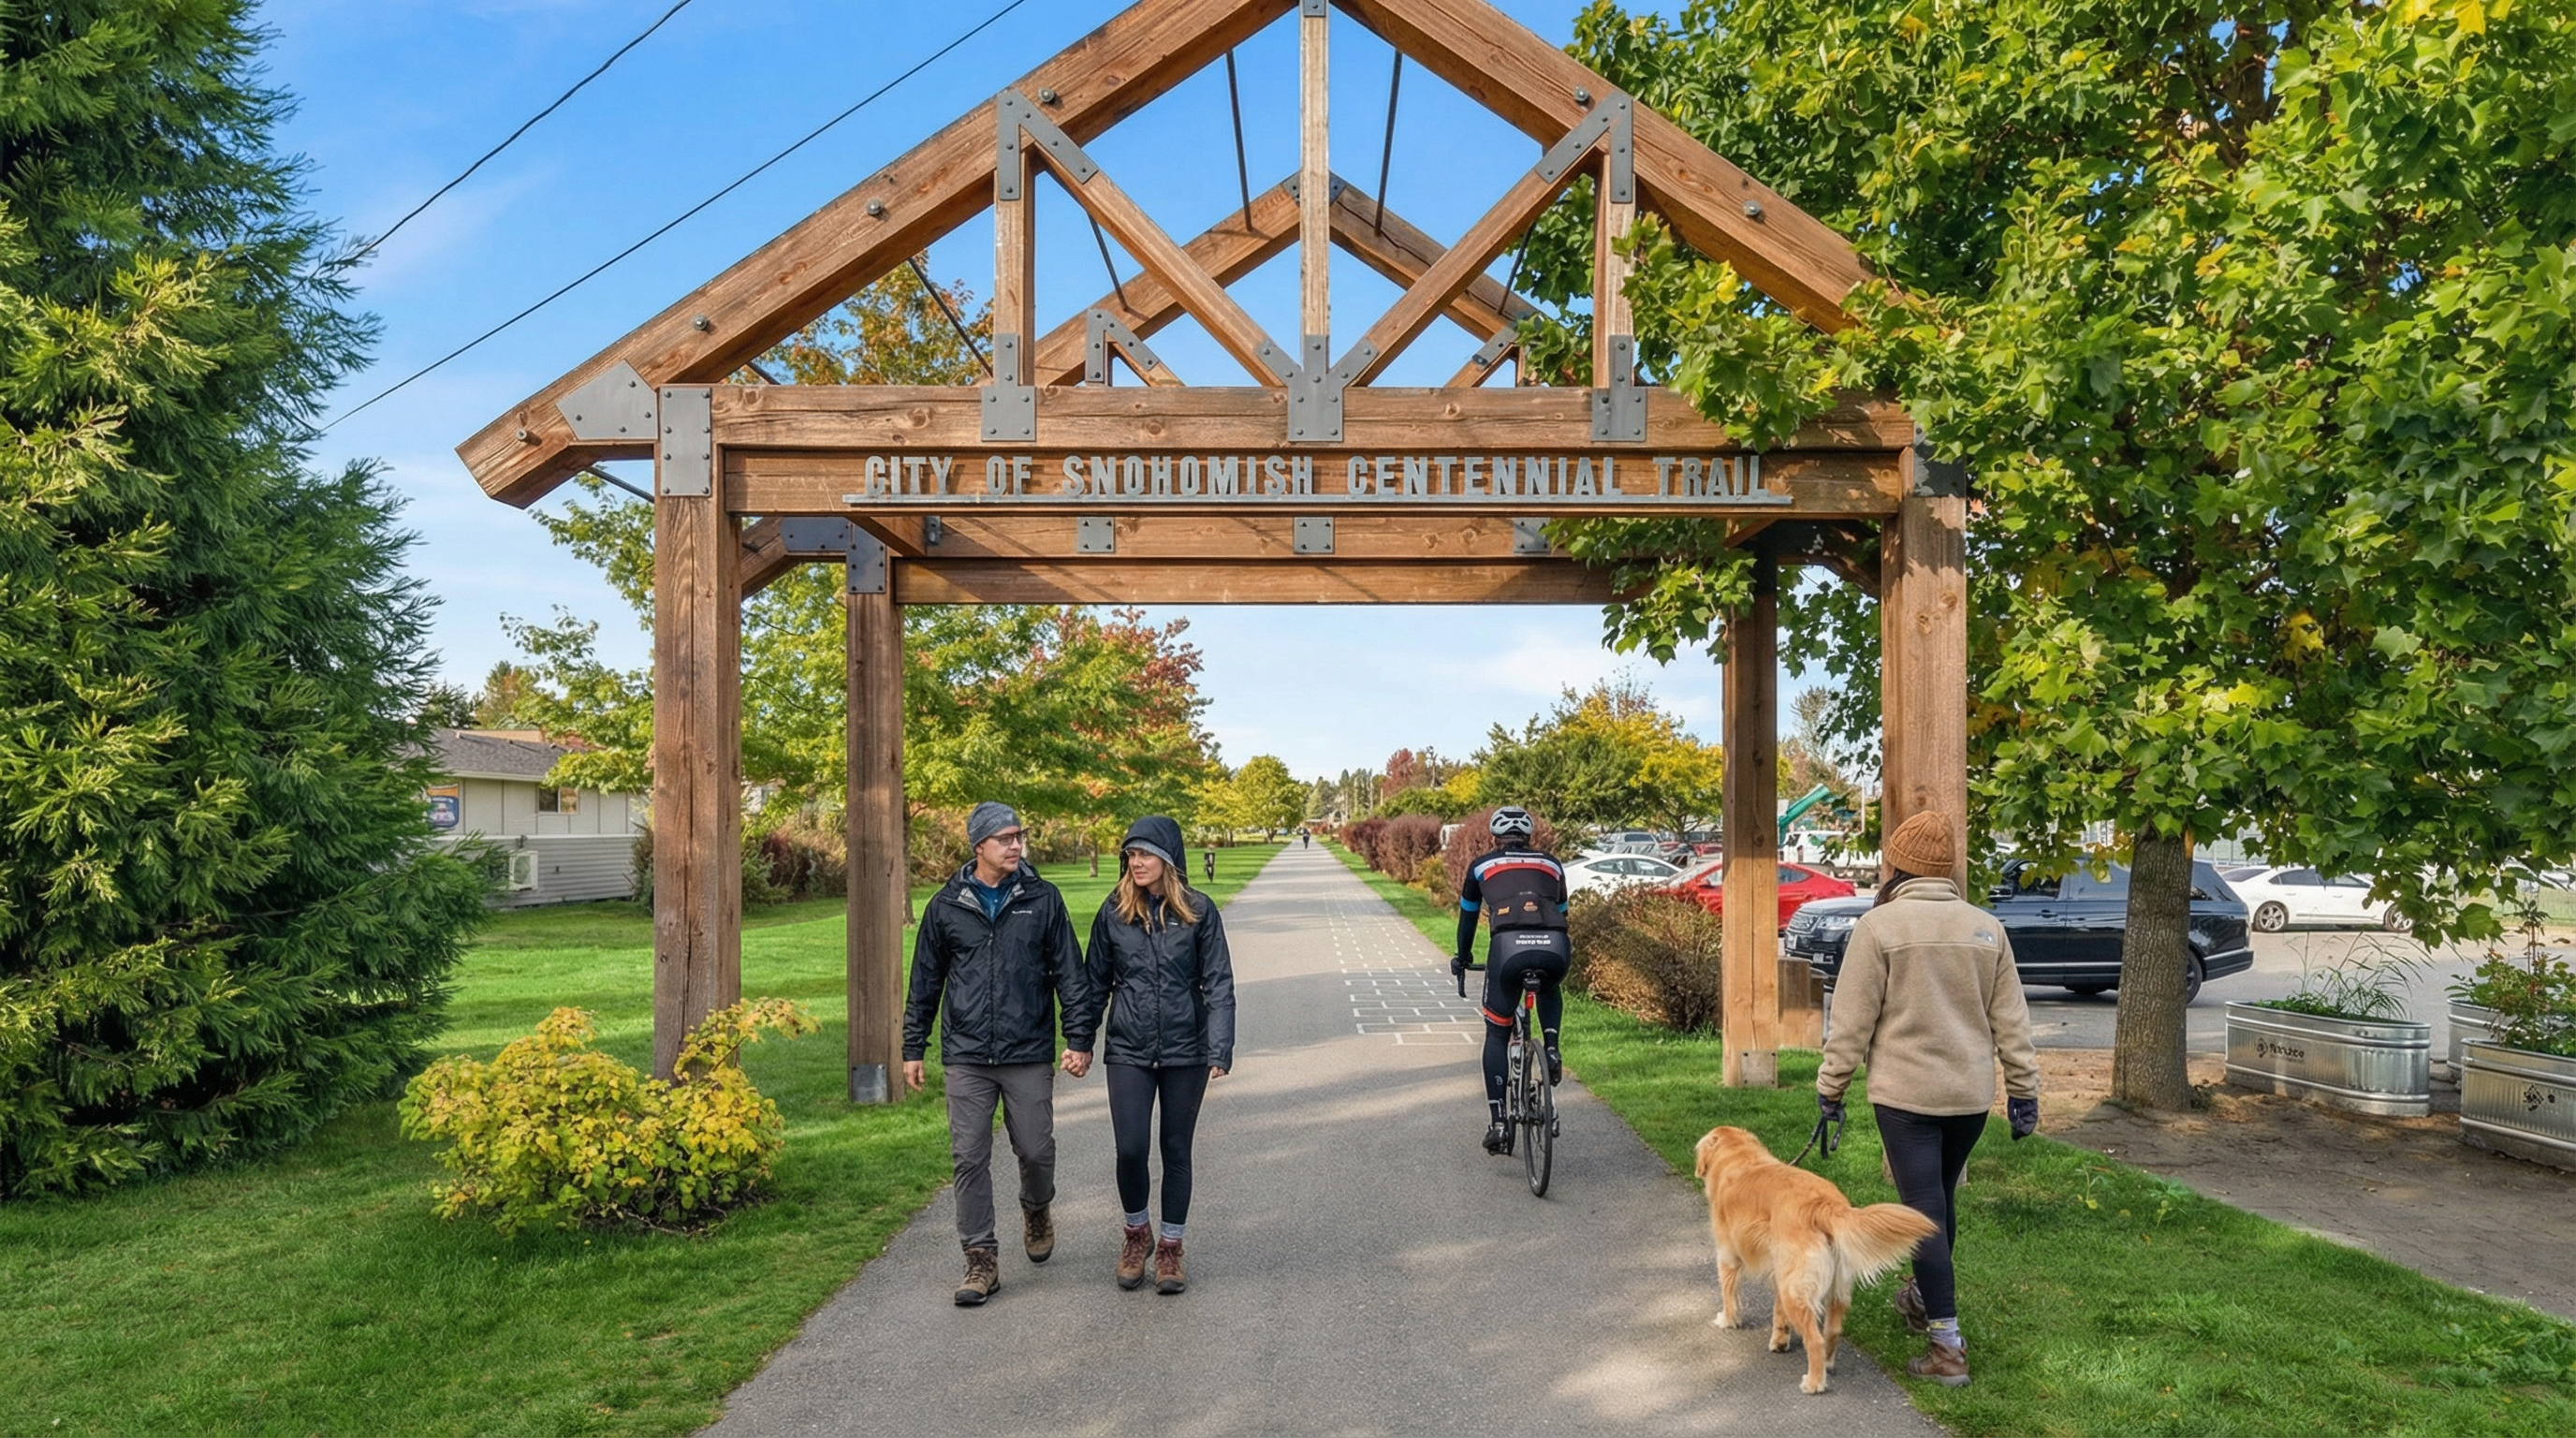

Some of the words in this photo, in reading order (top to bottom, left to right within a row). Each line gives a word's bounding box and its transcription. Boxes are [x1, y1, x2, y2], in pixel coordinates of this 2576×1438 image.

[865, 455, 953, 496] CITY
[986, 455, 1032, 496] OF
[1061, 455, 1312, 497] SNOHOMISH
[1347, 455, 1622, 496] CENTENNIAL
[1653, 455, 1769, 497] TRAIL
